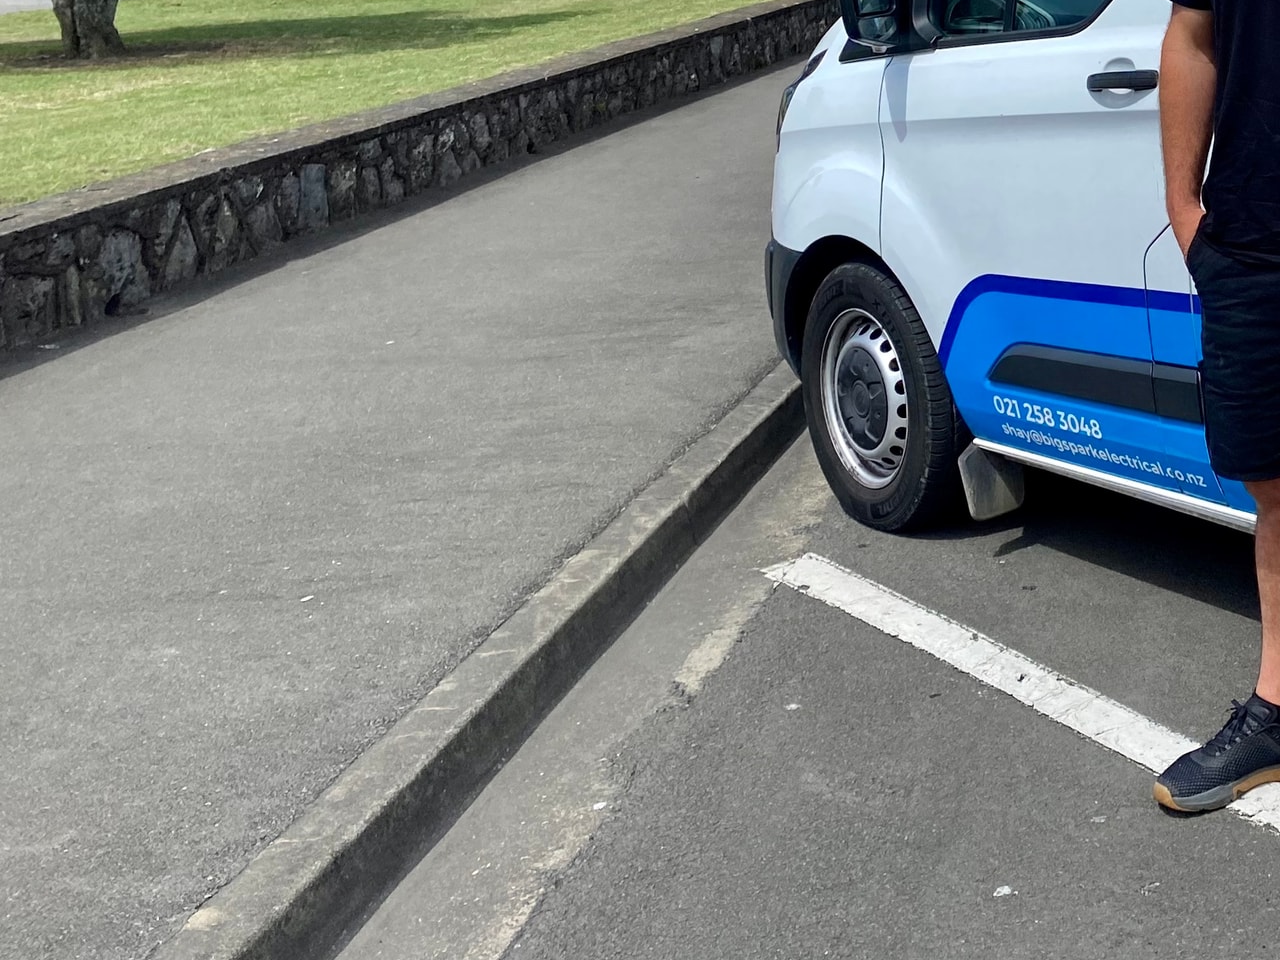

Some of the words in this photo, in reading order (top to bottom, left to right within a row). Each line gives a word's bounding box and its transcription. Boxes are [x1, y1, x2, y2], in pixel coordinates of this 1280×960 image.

[993, 395, 1020, 418] 021
[1023, 403, 1055, 427] 258
[1057, 411, 1103, 439] 3048
[1002, 423, 1208, 488] shay@bigsparkelectrical.co.nz
